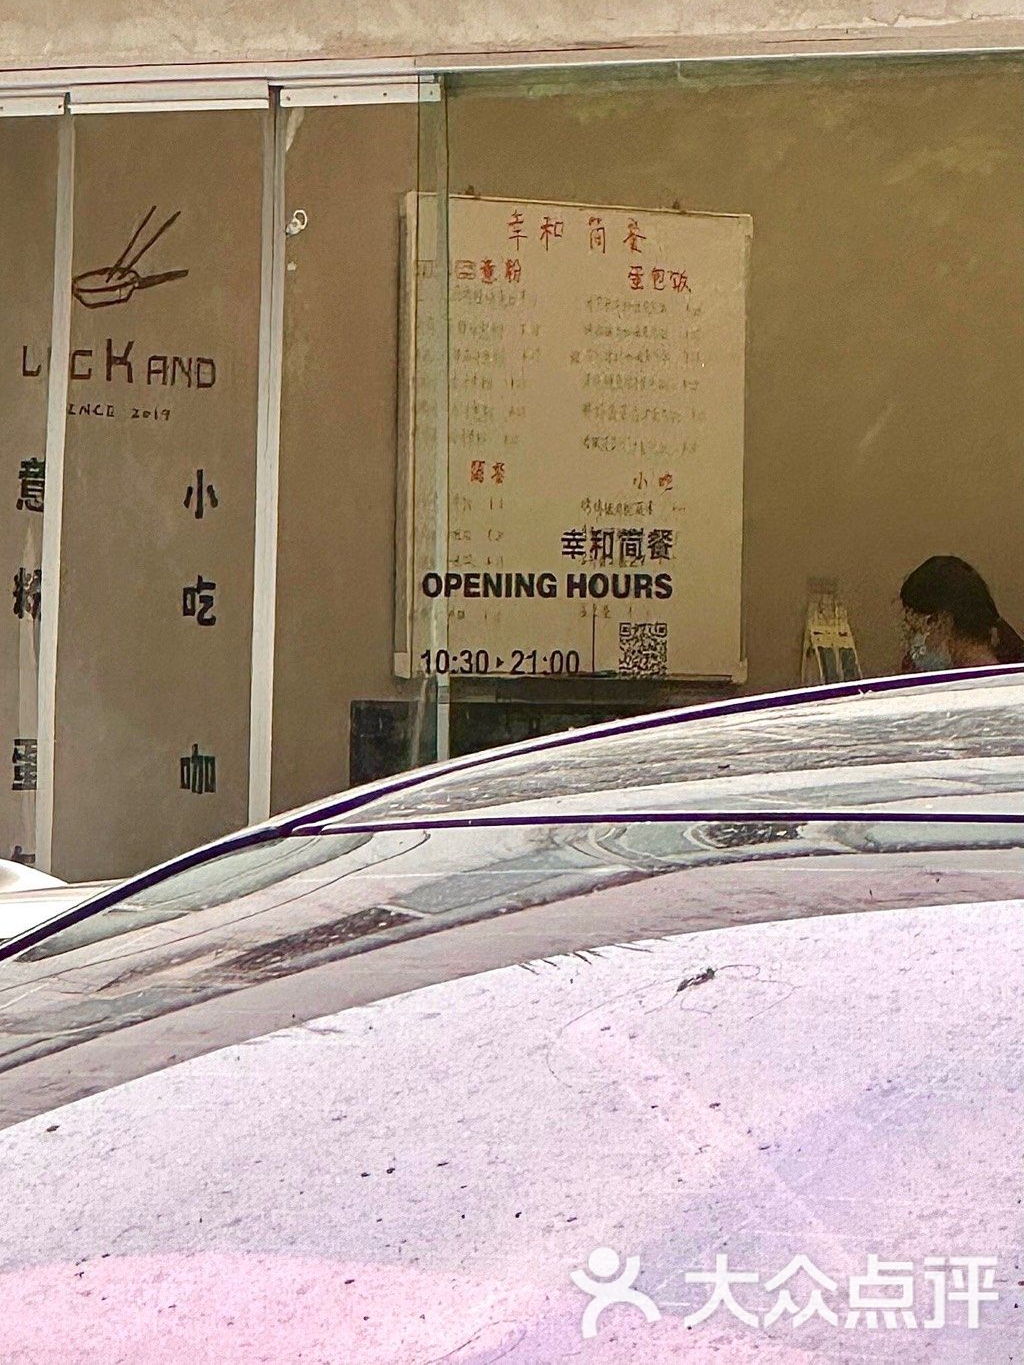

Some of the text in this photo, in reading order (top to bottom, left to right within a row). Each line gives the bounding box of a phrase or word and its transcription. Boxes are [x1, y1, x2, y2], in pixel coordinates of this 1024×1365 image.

[22, 338, 217, 389] LCKAND
[130, 407, 171, 421] 2019
[560, 528, 674, 560] 幸和简餐
[422, 572, 674, 600] OPENING HOURS
[421, 649, 580, 675] 10:30 21:00
